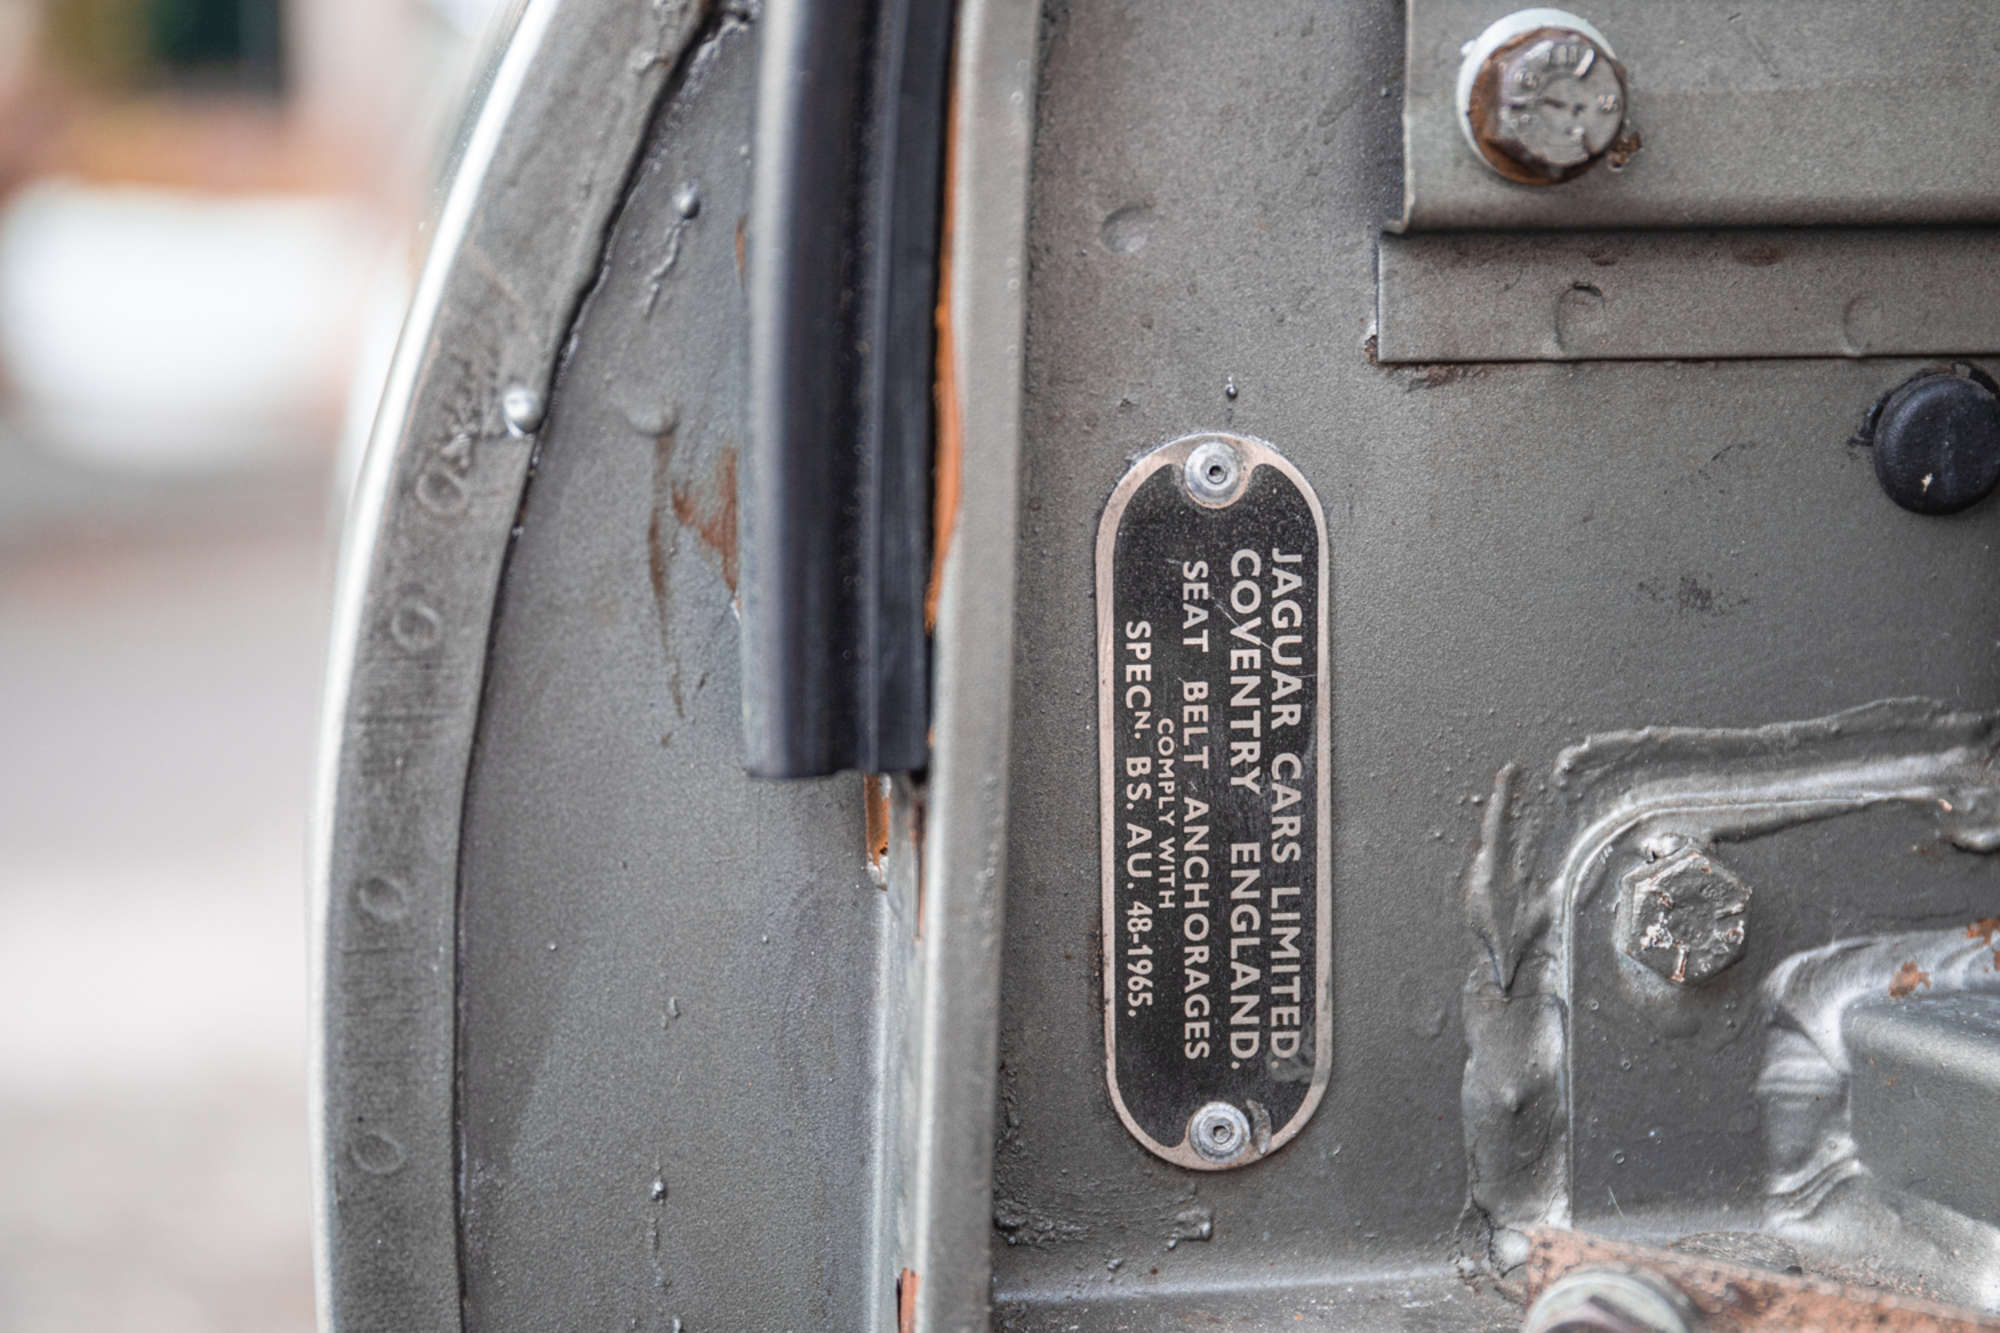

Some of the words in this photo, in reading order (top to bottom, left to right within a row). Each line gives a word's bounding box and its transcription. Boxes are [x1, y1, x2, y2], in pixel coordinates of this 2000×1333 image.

[1183, 561, 1209, 652] SEAT
[1271, 548, 1302, 729] JAGUAR
[1183, 681, 1209, 769] BELT
[1230, 549, 1261, 795] COVENTRY
[1126, 756, 1152, 809] BS.
[1158, 718, 1175, 826] COMPLY
[1271, 753, 1303, 863] CARS
[1127, 823, 1152, 889] AU.
[1159, 837, 1175, 908] WITH
[1184, 797, 1209, 1059] ANCHORAGES
[1231, 842, 1260, 1069] ENGLAND.
[1271, 887, 1300, 1069] LIMITED.
